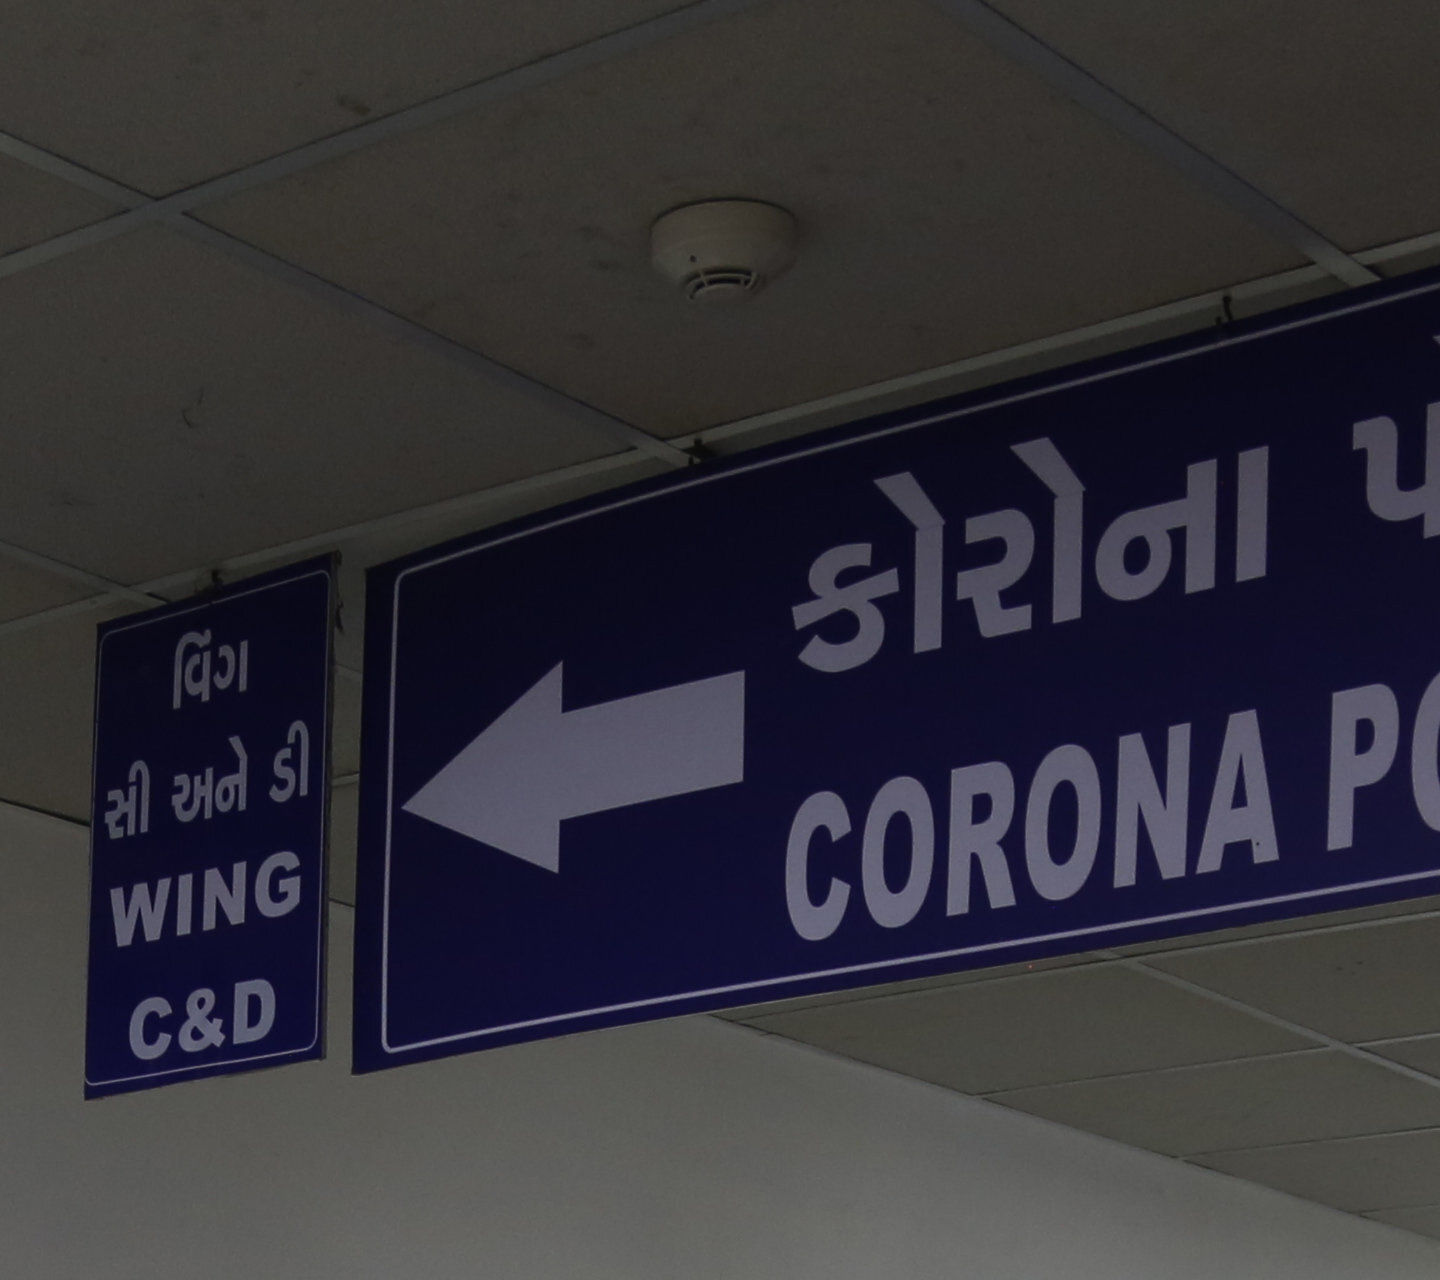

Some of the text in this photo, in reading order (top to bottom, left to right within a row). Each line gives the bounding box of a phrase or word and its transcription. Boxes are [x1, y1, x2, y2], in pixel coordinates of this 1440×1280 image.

[791, 437, 1269, 673] કોરોના
[173, 629, 248, 709] વિંગ
[104, 720, 309, 839] સી અને ડી
[785, 709, 1279, 941] CORONA
[110, 851, 301, 947] WING
[129, 979, 276, 1060] C&D
